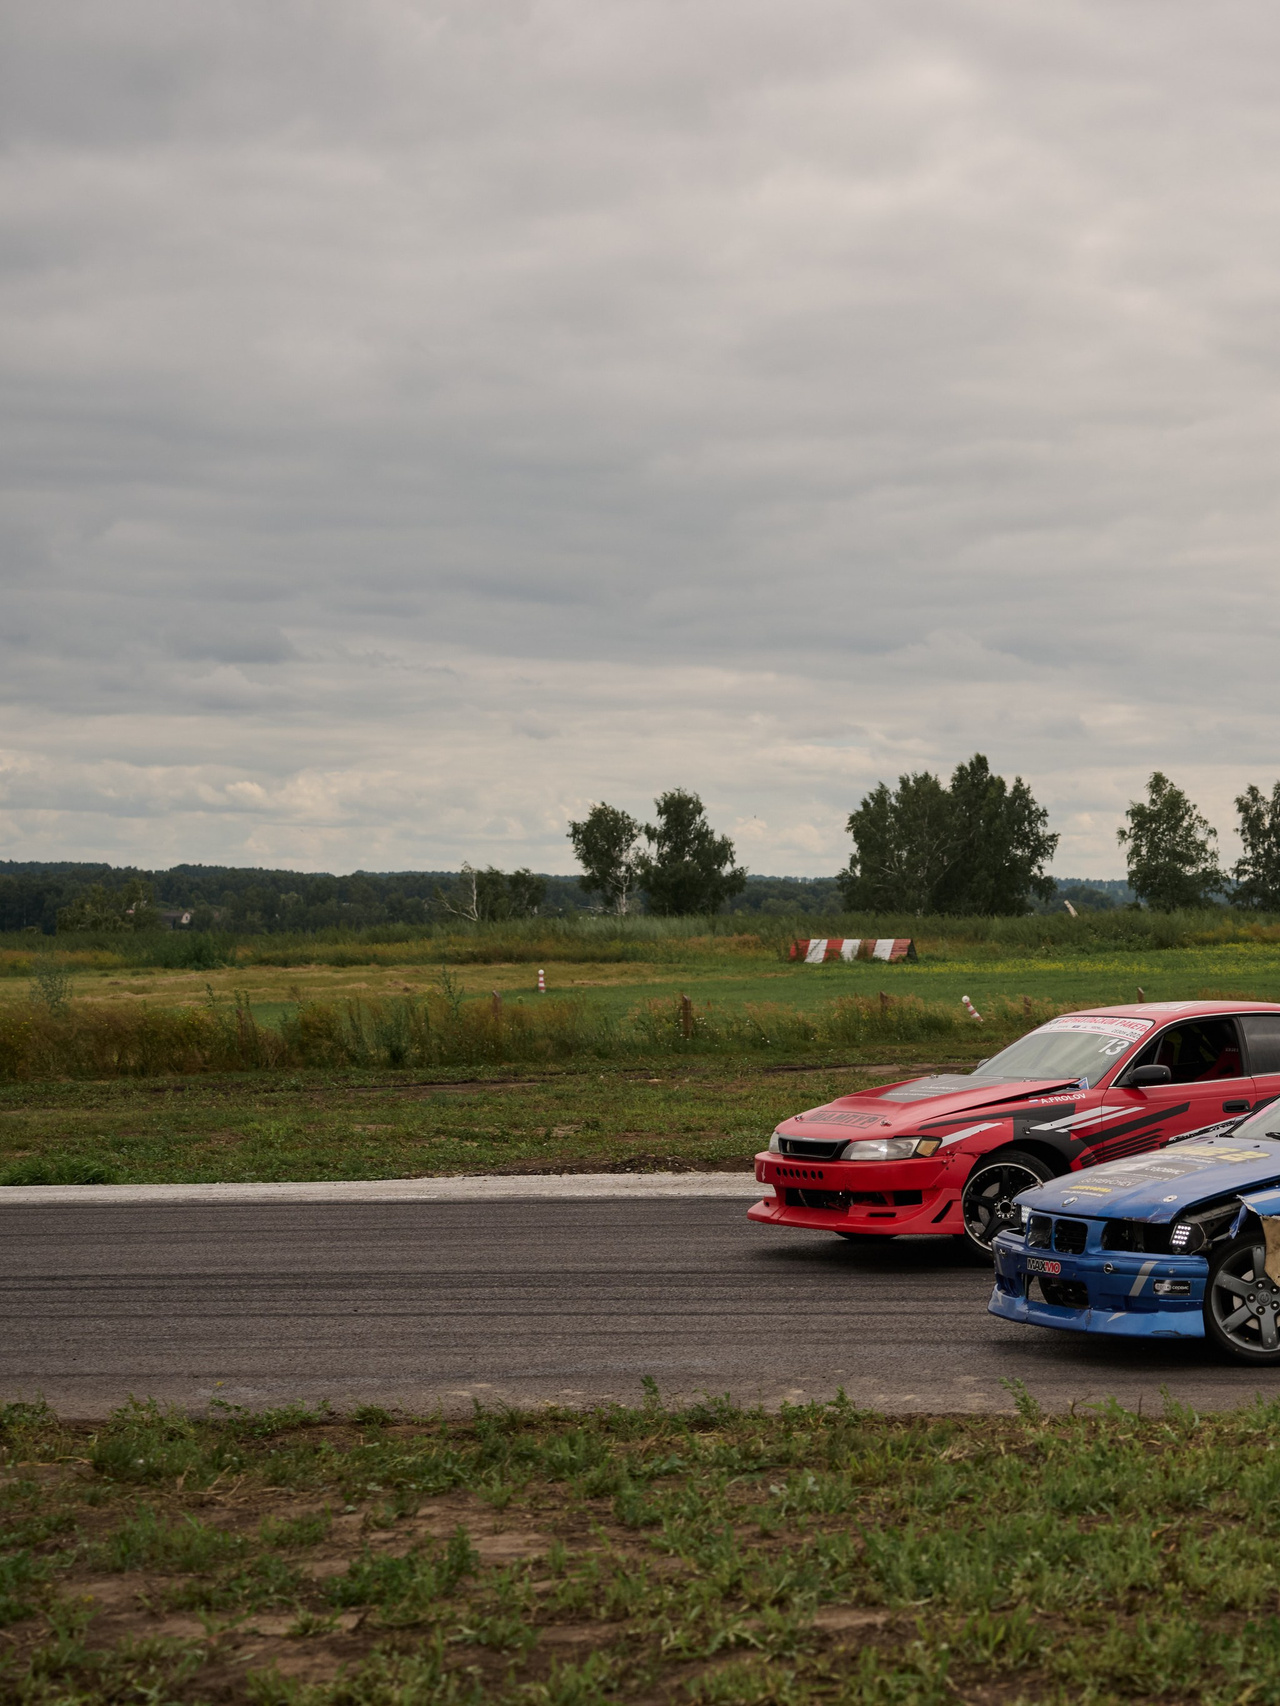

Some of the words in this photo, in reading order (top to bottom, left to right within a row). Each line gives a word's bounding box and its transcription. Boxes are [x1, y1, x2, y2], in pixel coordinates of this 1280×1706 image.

[1098, 1038, 1129, 1056] 13
[1041, 1093, 1086, 1104] A.FROLOV
[1027, 1257, 1062, 1275] MAXMO
